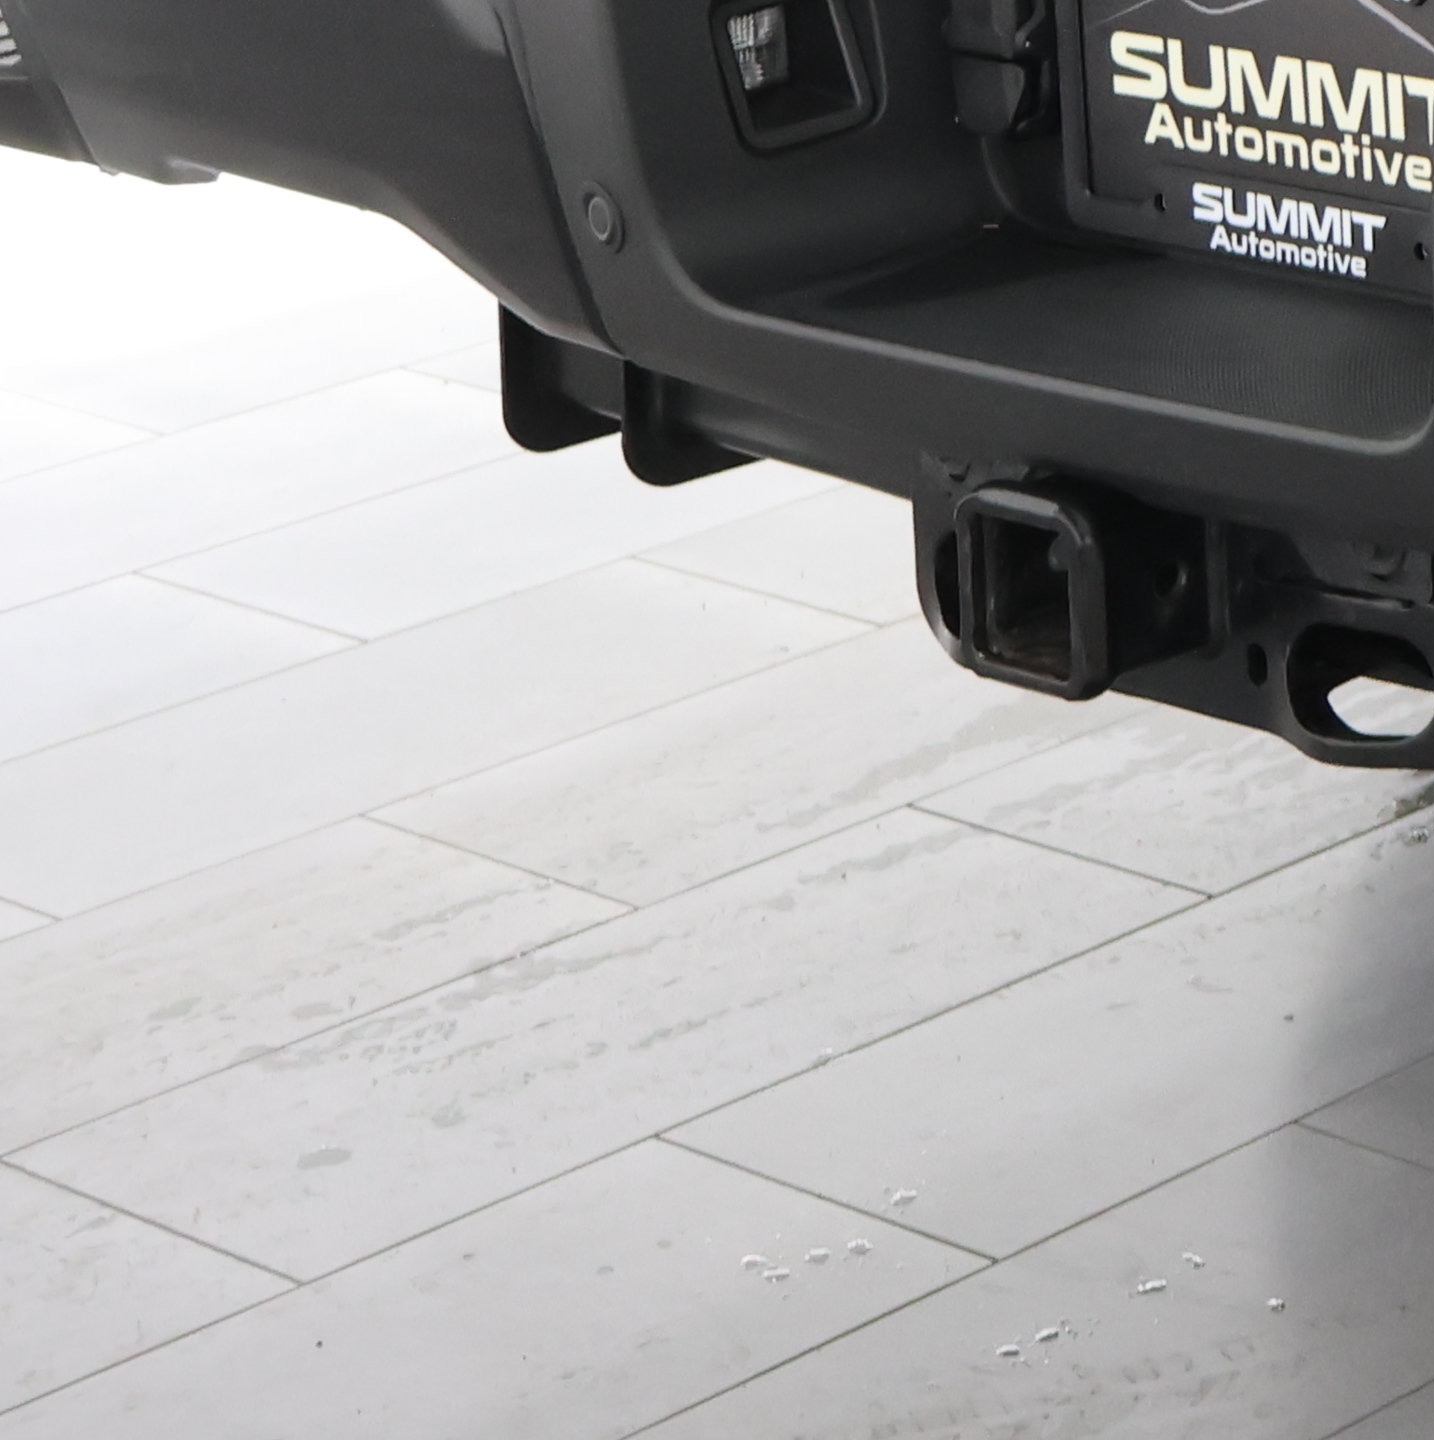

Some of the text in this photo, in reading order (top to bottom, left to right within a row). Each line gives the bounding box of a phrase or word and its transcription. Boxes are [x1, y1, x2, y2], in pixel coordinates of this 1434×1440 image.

[1144, 101, 1434, 193] Automotive
[1192, 182, 1387, 253] SUMMIT
[1209, 224, 1368, 280] Automotive
